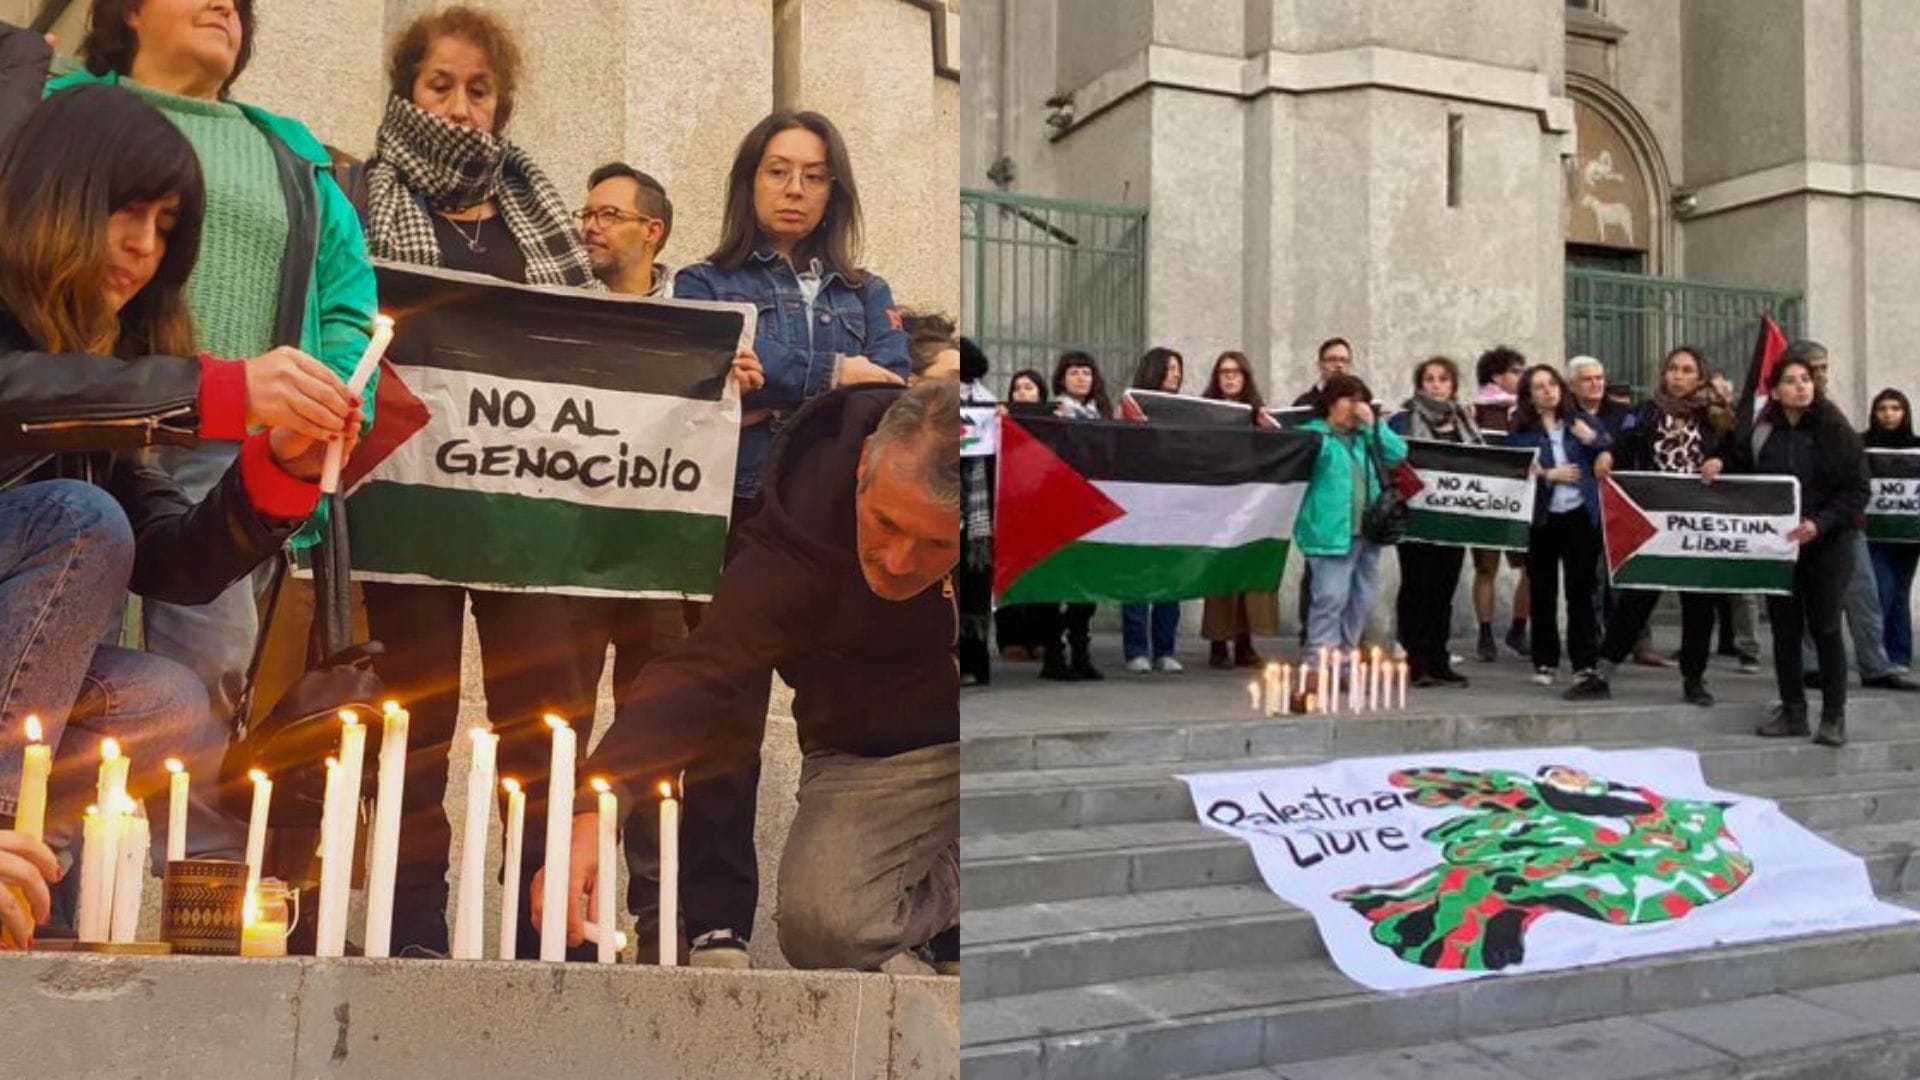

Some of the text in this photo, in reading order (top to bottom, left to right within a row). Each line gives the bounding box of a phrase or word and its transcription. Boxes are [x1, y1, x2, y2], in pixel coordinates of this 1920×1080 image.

[467, 387, 621, 437] NO AL
[1437, 477, 1489, 493] NO AL
[1880, 482, 1905, 496] NO
[1207, 787, 1404, 826] Palestina
